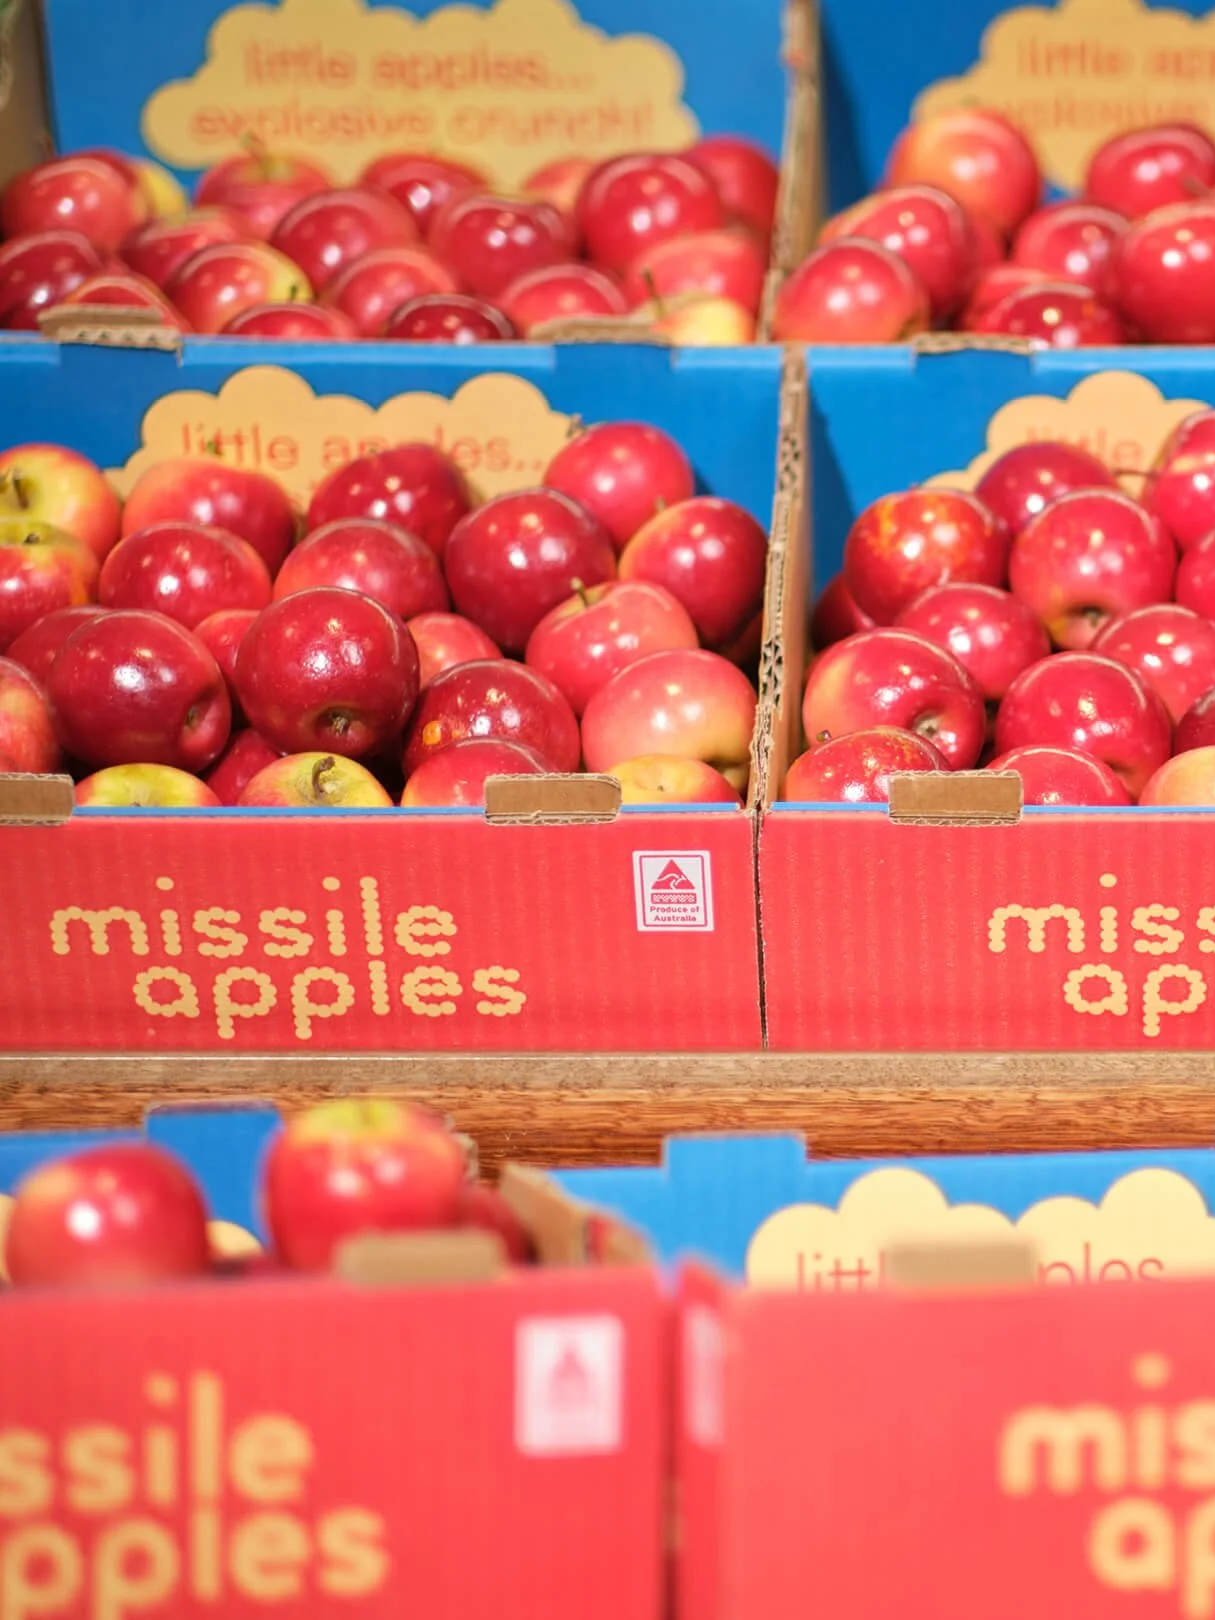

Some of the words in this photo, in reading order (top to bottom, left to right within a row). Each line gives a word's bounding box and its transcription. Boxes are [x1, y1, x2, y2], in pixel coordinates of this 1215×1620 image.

[50, 876, 457, 957] missile
[133, 960, 527, 1039] apples
[796, 1250, 888, 1293] littl
